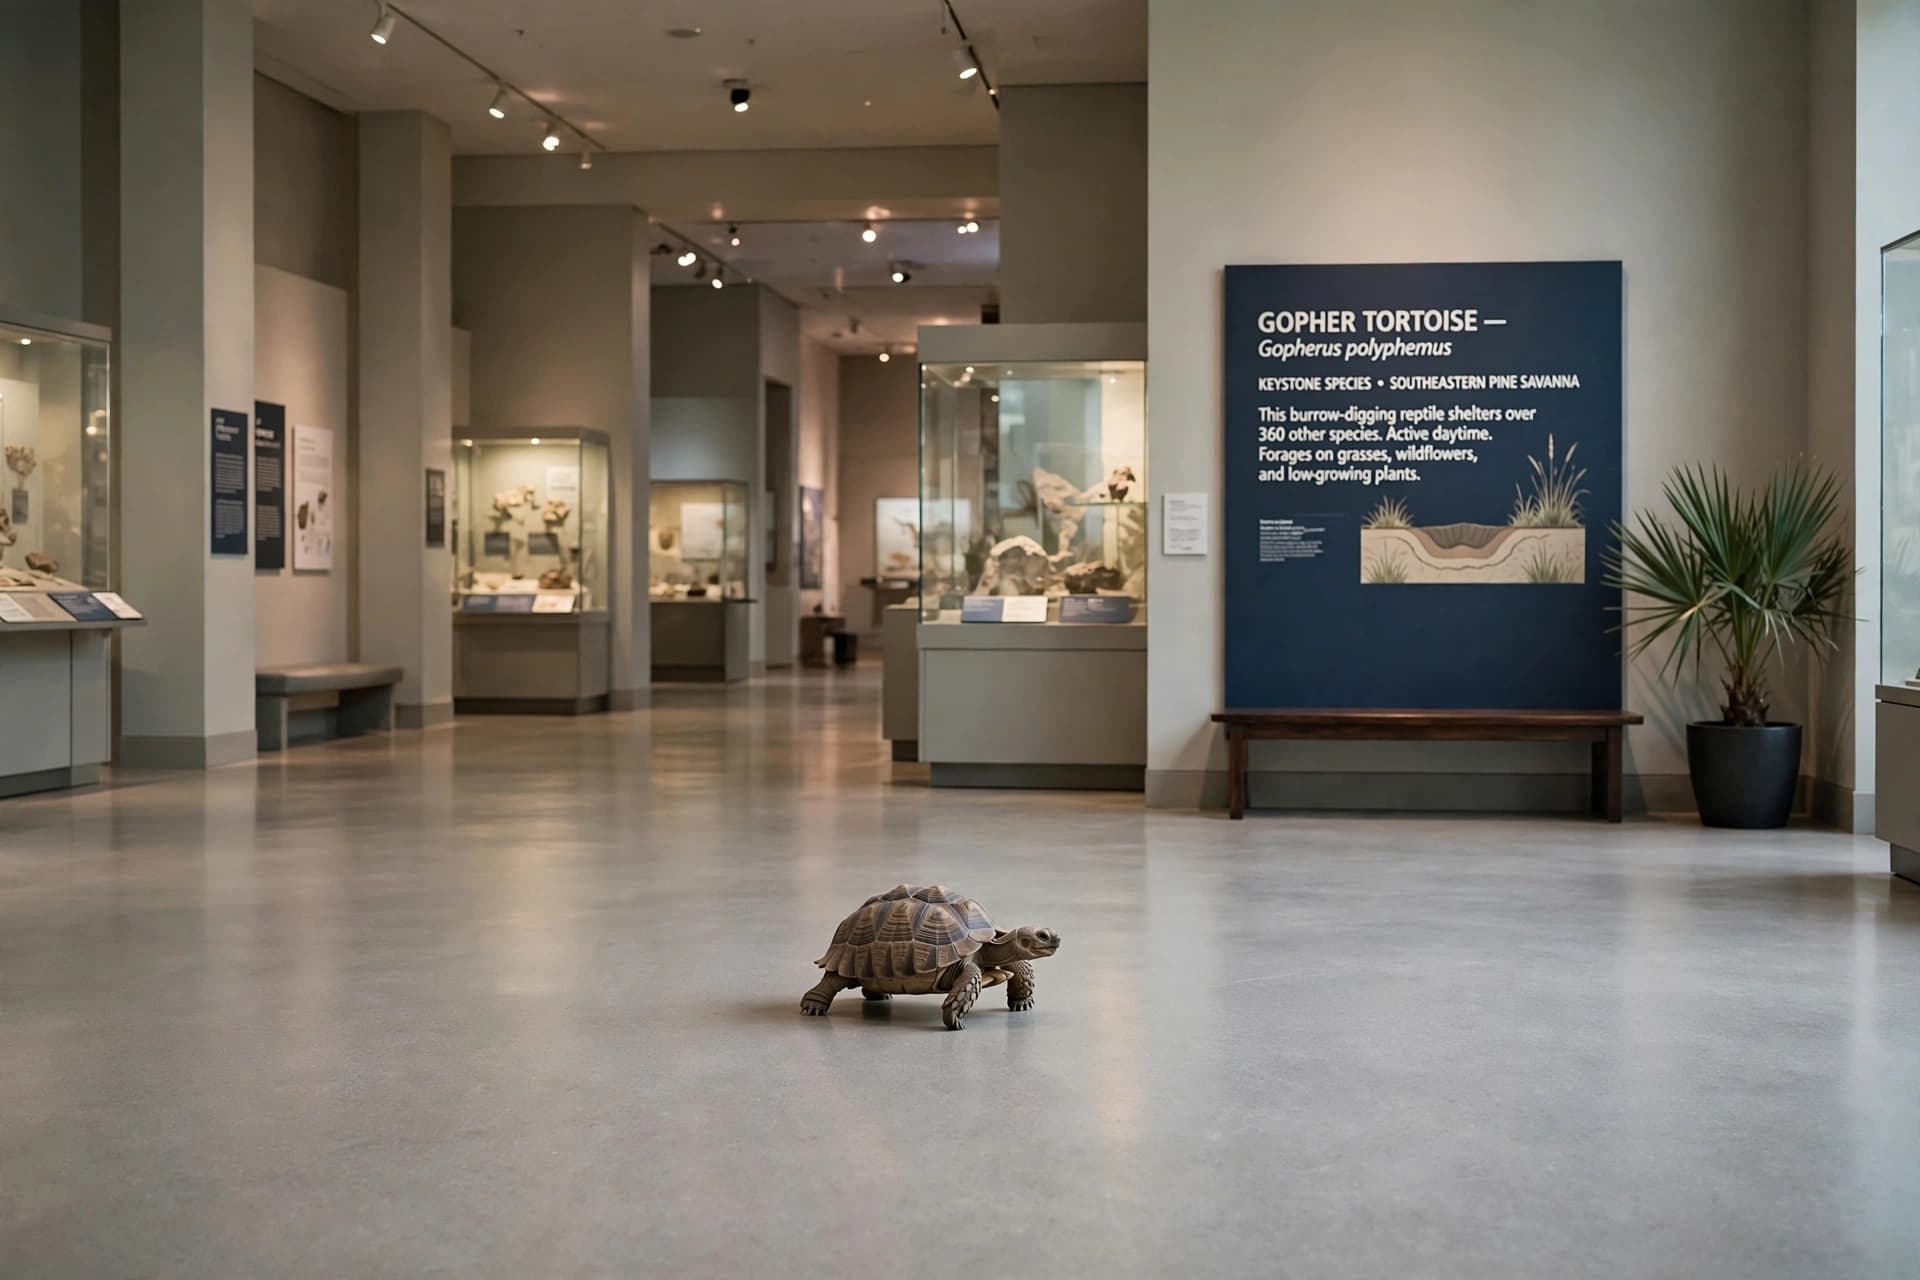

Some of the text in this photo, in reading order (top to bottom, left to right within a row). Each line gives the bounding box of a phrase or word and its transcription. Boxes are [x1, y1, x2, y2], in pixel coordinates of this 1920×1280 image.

[1258, 311, 1356, 333] GOPHER
[1362, 309, 1478, 332] TORTOISE
[1259, 337, 1452, 362] Gopherus polyphemus
[1259, 377, 1321, 391] KEYSTONE
[1325, 376, 1372, 390] SPECIES
[1390, 376, 1486, 390] SOUTHEASTERN
[1489, 375, 1517, 389] PINE
[1520, 374, 1580, 389] SAVANNA
[1258, 405, 1536, 426] This burrow-digging reptile shelters over
[1259, 424, 1493, 445] 360 other species. Active daytime.
[1259, 445, 1478, 466] Forages on grasses, wildflowers,
[1259, 465, 1420, 485] and low-growing plants.
